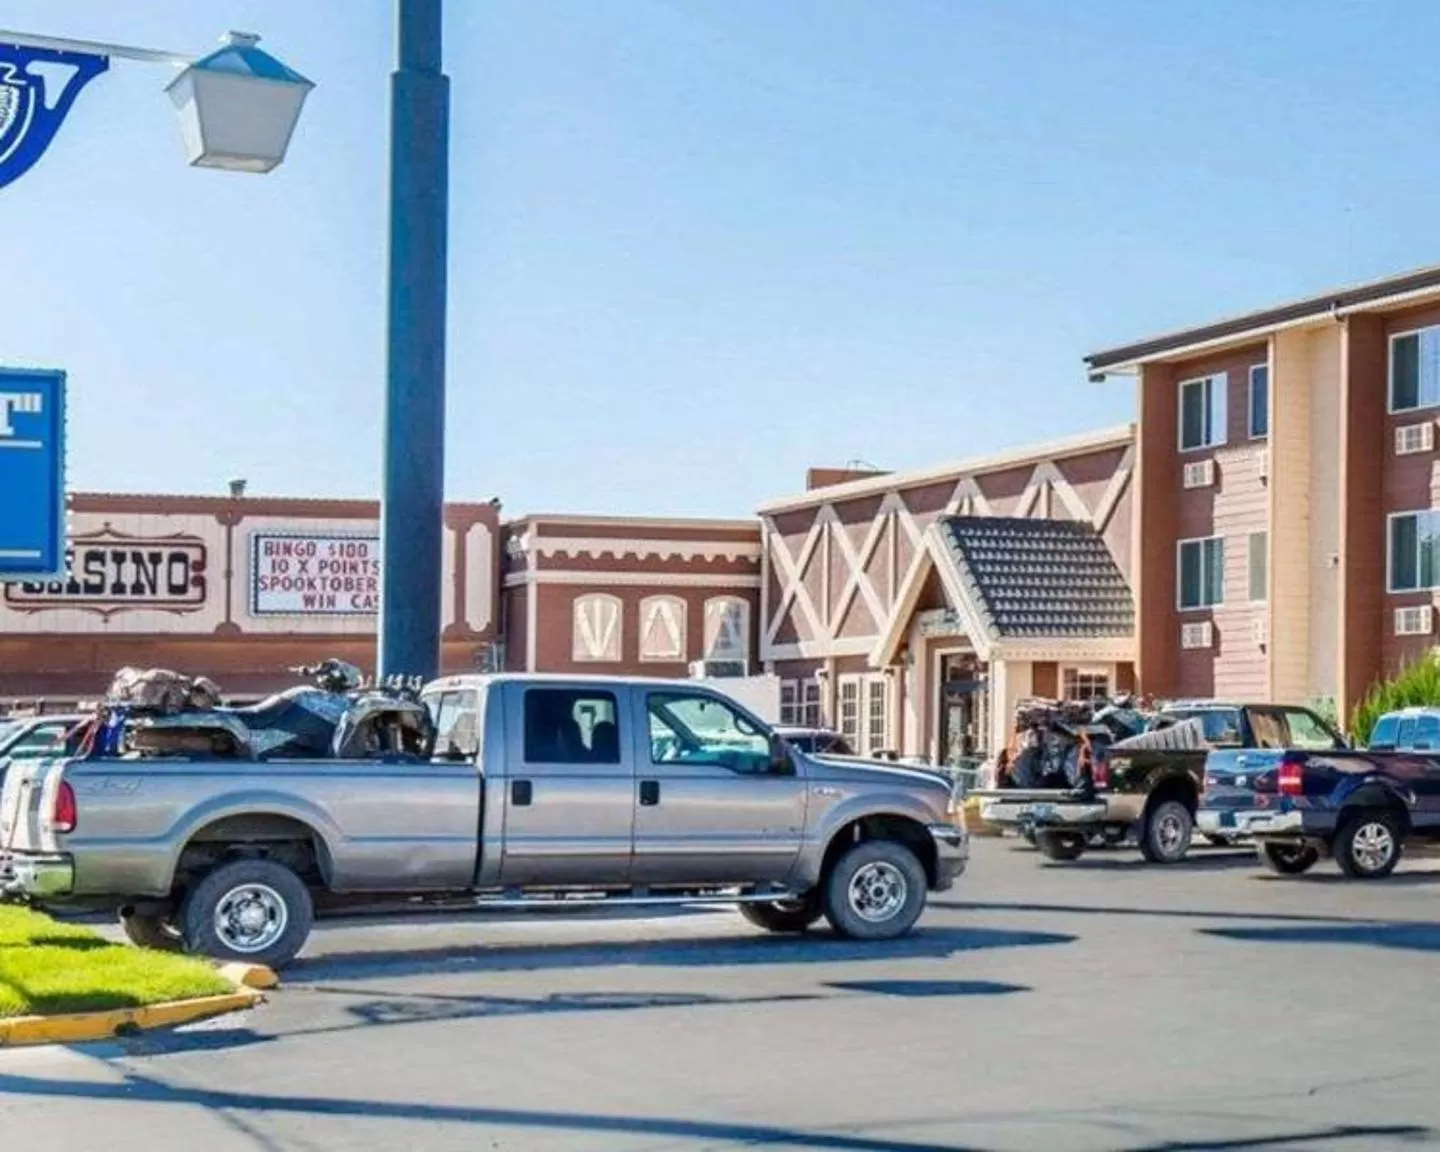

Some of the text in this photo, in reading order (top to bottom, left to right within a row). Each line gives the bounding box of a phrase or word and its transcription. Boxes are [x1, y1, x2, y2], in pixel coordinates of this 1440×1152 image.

[264, 540, 369, 558] BINGO $100
[271, 558, 380, 576] 10 X POINTS
[259, 575, 378, 591] SPOOKTOBER
[302, 594, 337, 609] WIN
